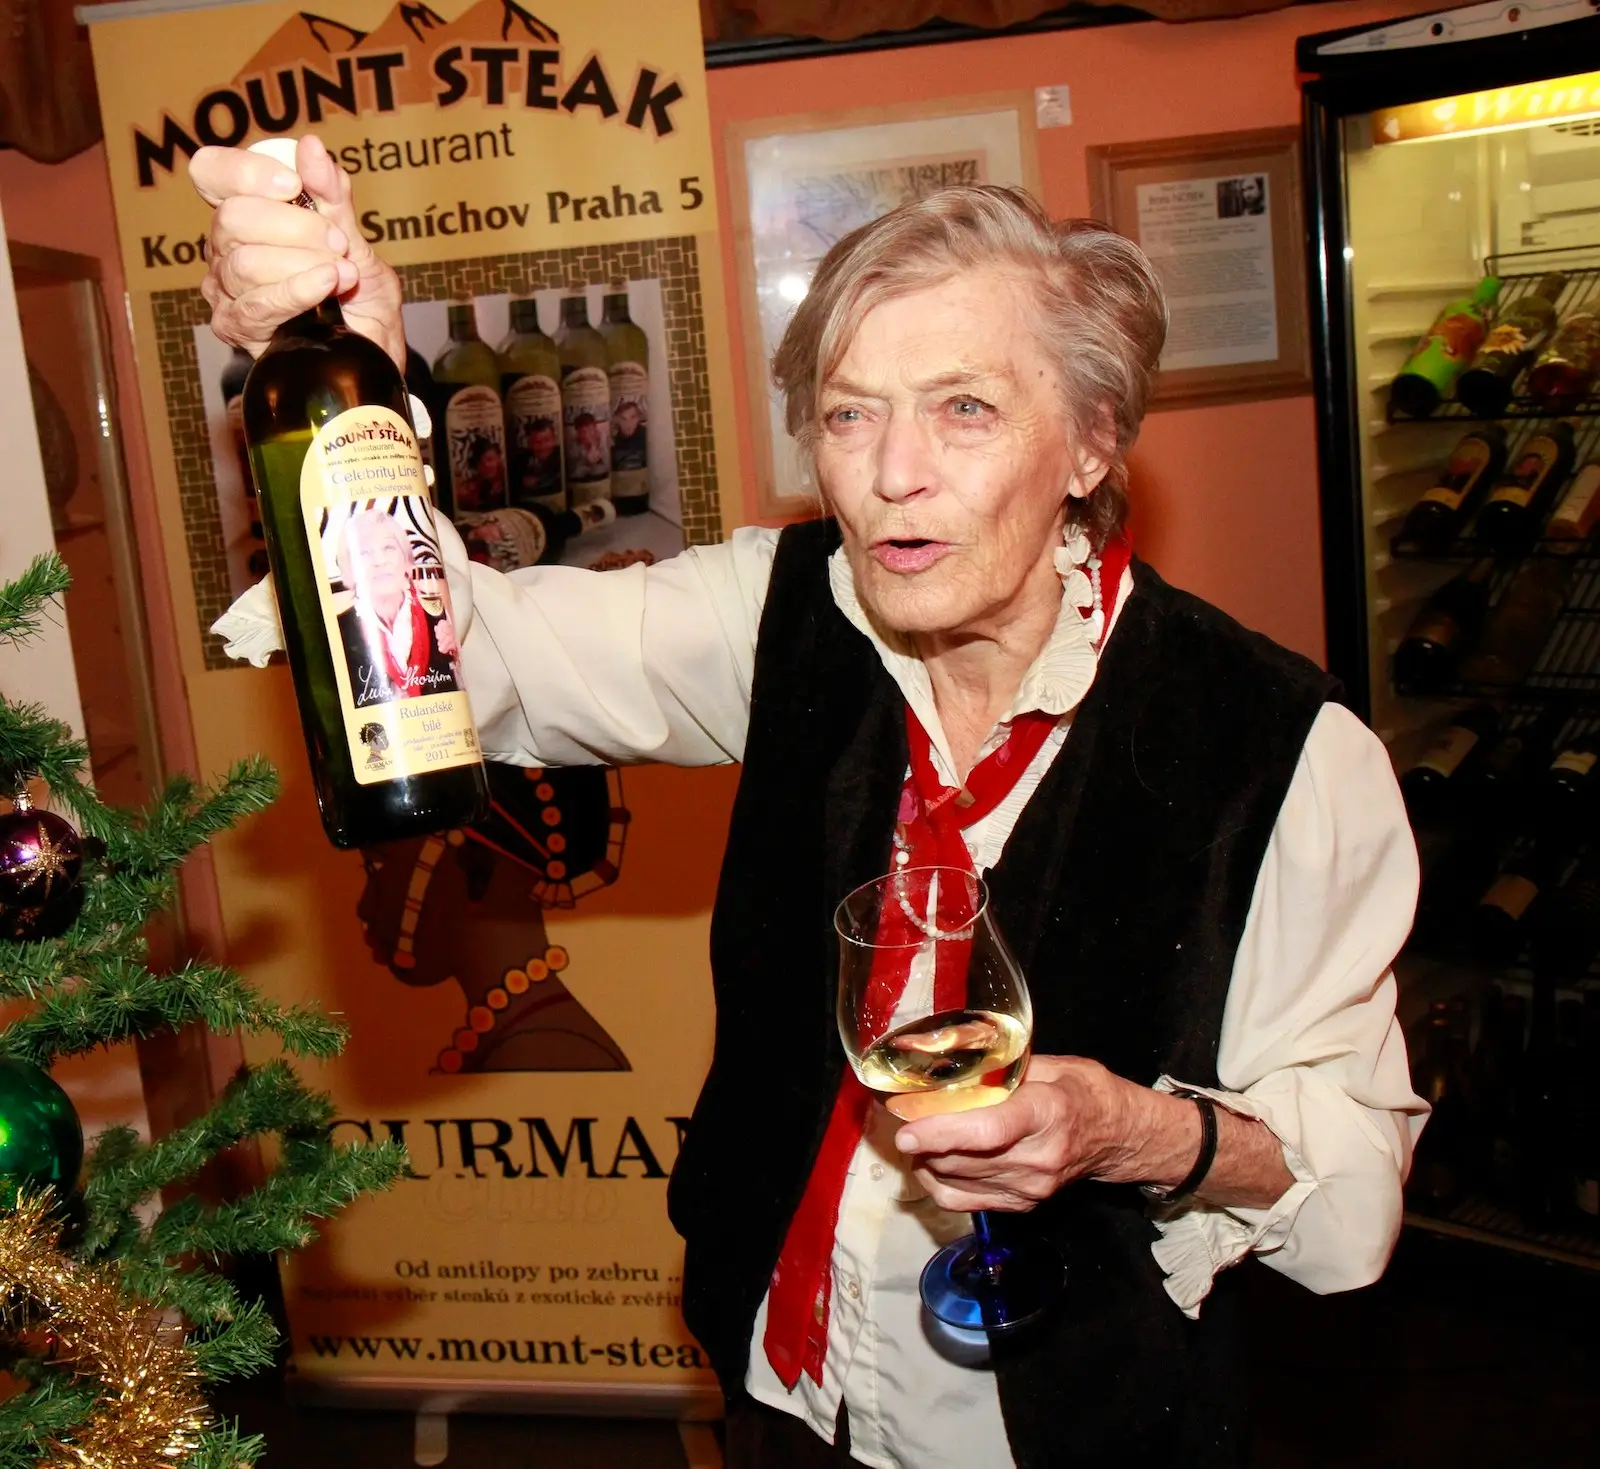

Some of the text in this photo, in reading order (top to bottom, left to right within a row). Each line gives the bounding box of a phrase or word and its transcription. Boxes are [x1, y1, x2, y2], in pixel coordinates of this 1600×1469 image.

[133, 46, 684, 187] MOUNT STEAK
[326, 122, 515, 175] staurant
[360, 198, 530, 244] Smíchov
[548, 184, 663, 225] Praha
[681, 177, 705, 209] 5
[323, 428, 413, 455] MOUNT STEAK
[331, 464, 418, 485] Celebrity Line
[399, 700, 454, 719] Rulandské
[425, 749, 450, 763] 2011
[395, 1259, 430, 1280] Od
[438, 1260, 541, 1286] antilopy
[550, 1265, 579, 1286] po
[586, 1261, 660, 1283] zebru
[515, 1293, 526, 1304] z
[530, 1289, 616, 1307] exotické
[307, 1333, 706, 1370] www.mount-stea
